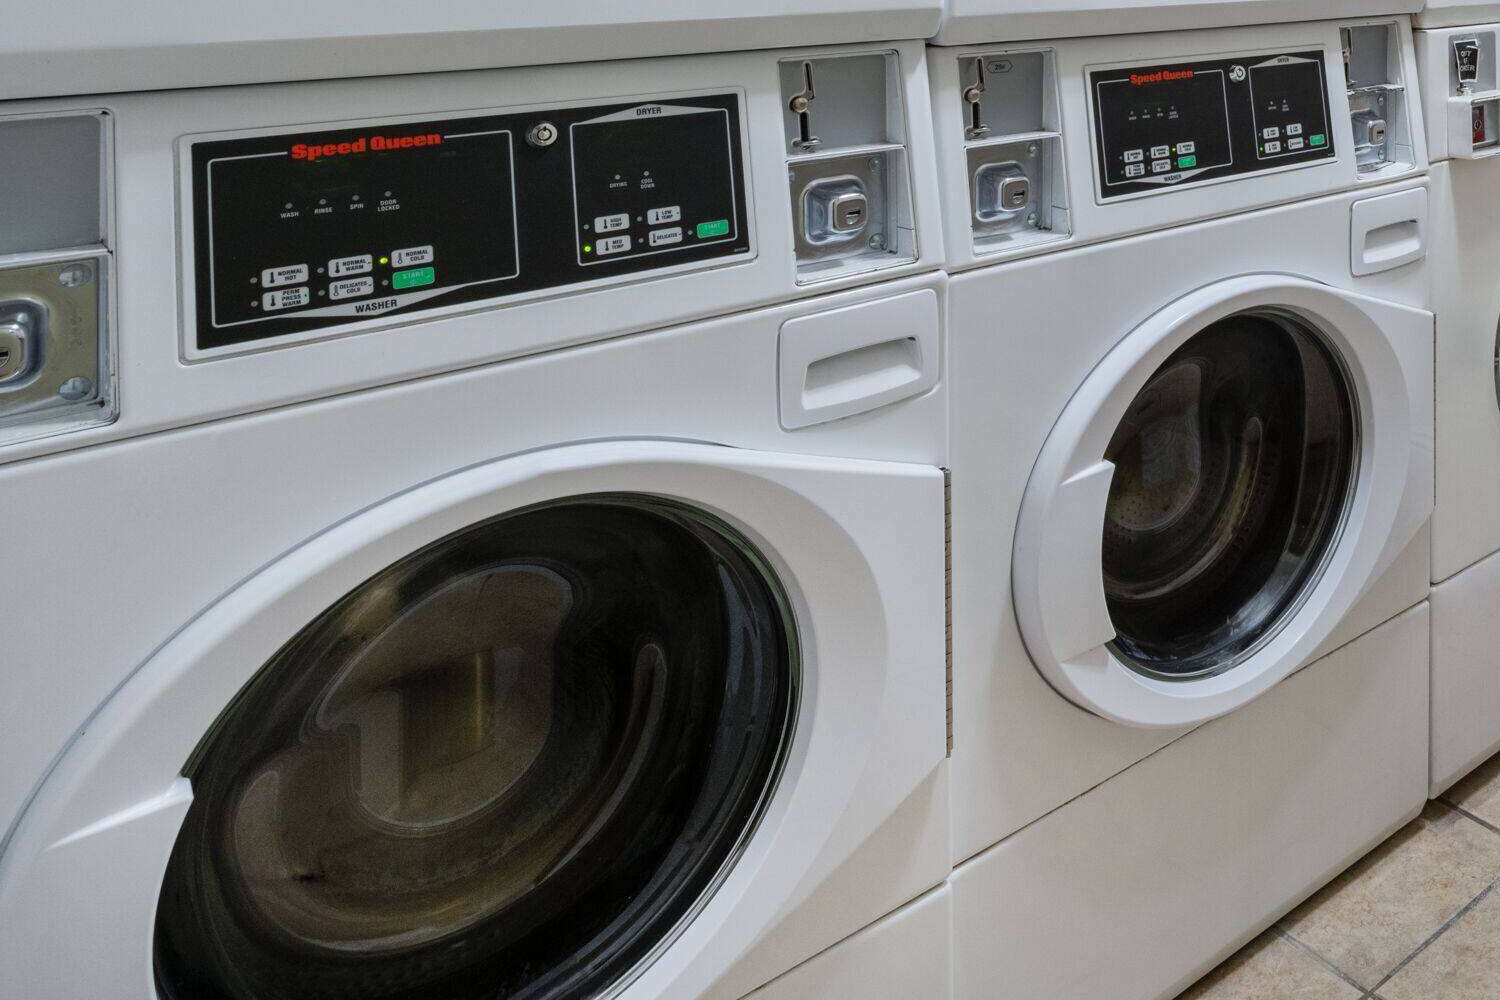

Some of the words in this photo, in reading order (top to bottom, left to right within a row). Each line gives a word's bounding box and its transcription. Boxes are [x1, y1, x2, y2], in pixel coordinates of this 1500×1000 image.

[1130, 71, 1161, 85] Speed
[1163, 70, 1193, 81] Queen
[636, 106, 662, 116] DRYER
[291, 137, 366, 161] Speed
[370, 133, 441, 151] Queen
[377, 204, 400, 212] LOCKED
[280, 211, 299, 219] WASH
[405, 249, 428, 257] NORMAL
[342, 258, 367, 267] NORMAL
[278, 267, 303, 277] NORMAL
[346, 264, 364, 272] WARM
[401, 271, 424, 280] START
[355, 299, 398, 313] WASHER
